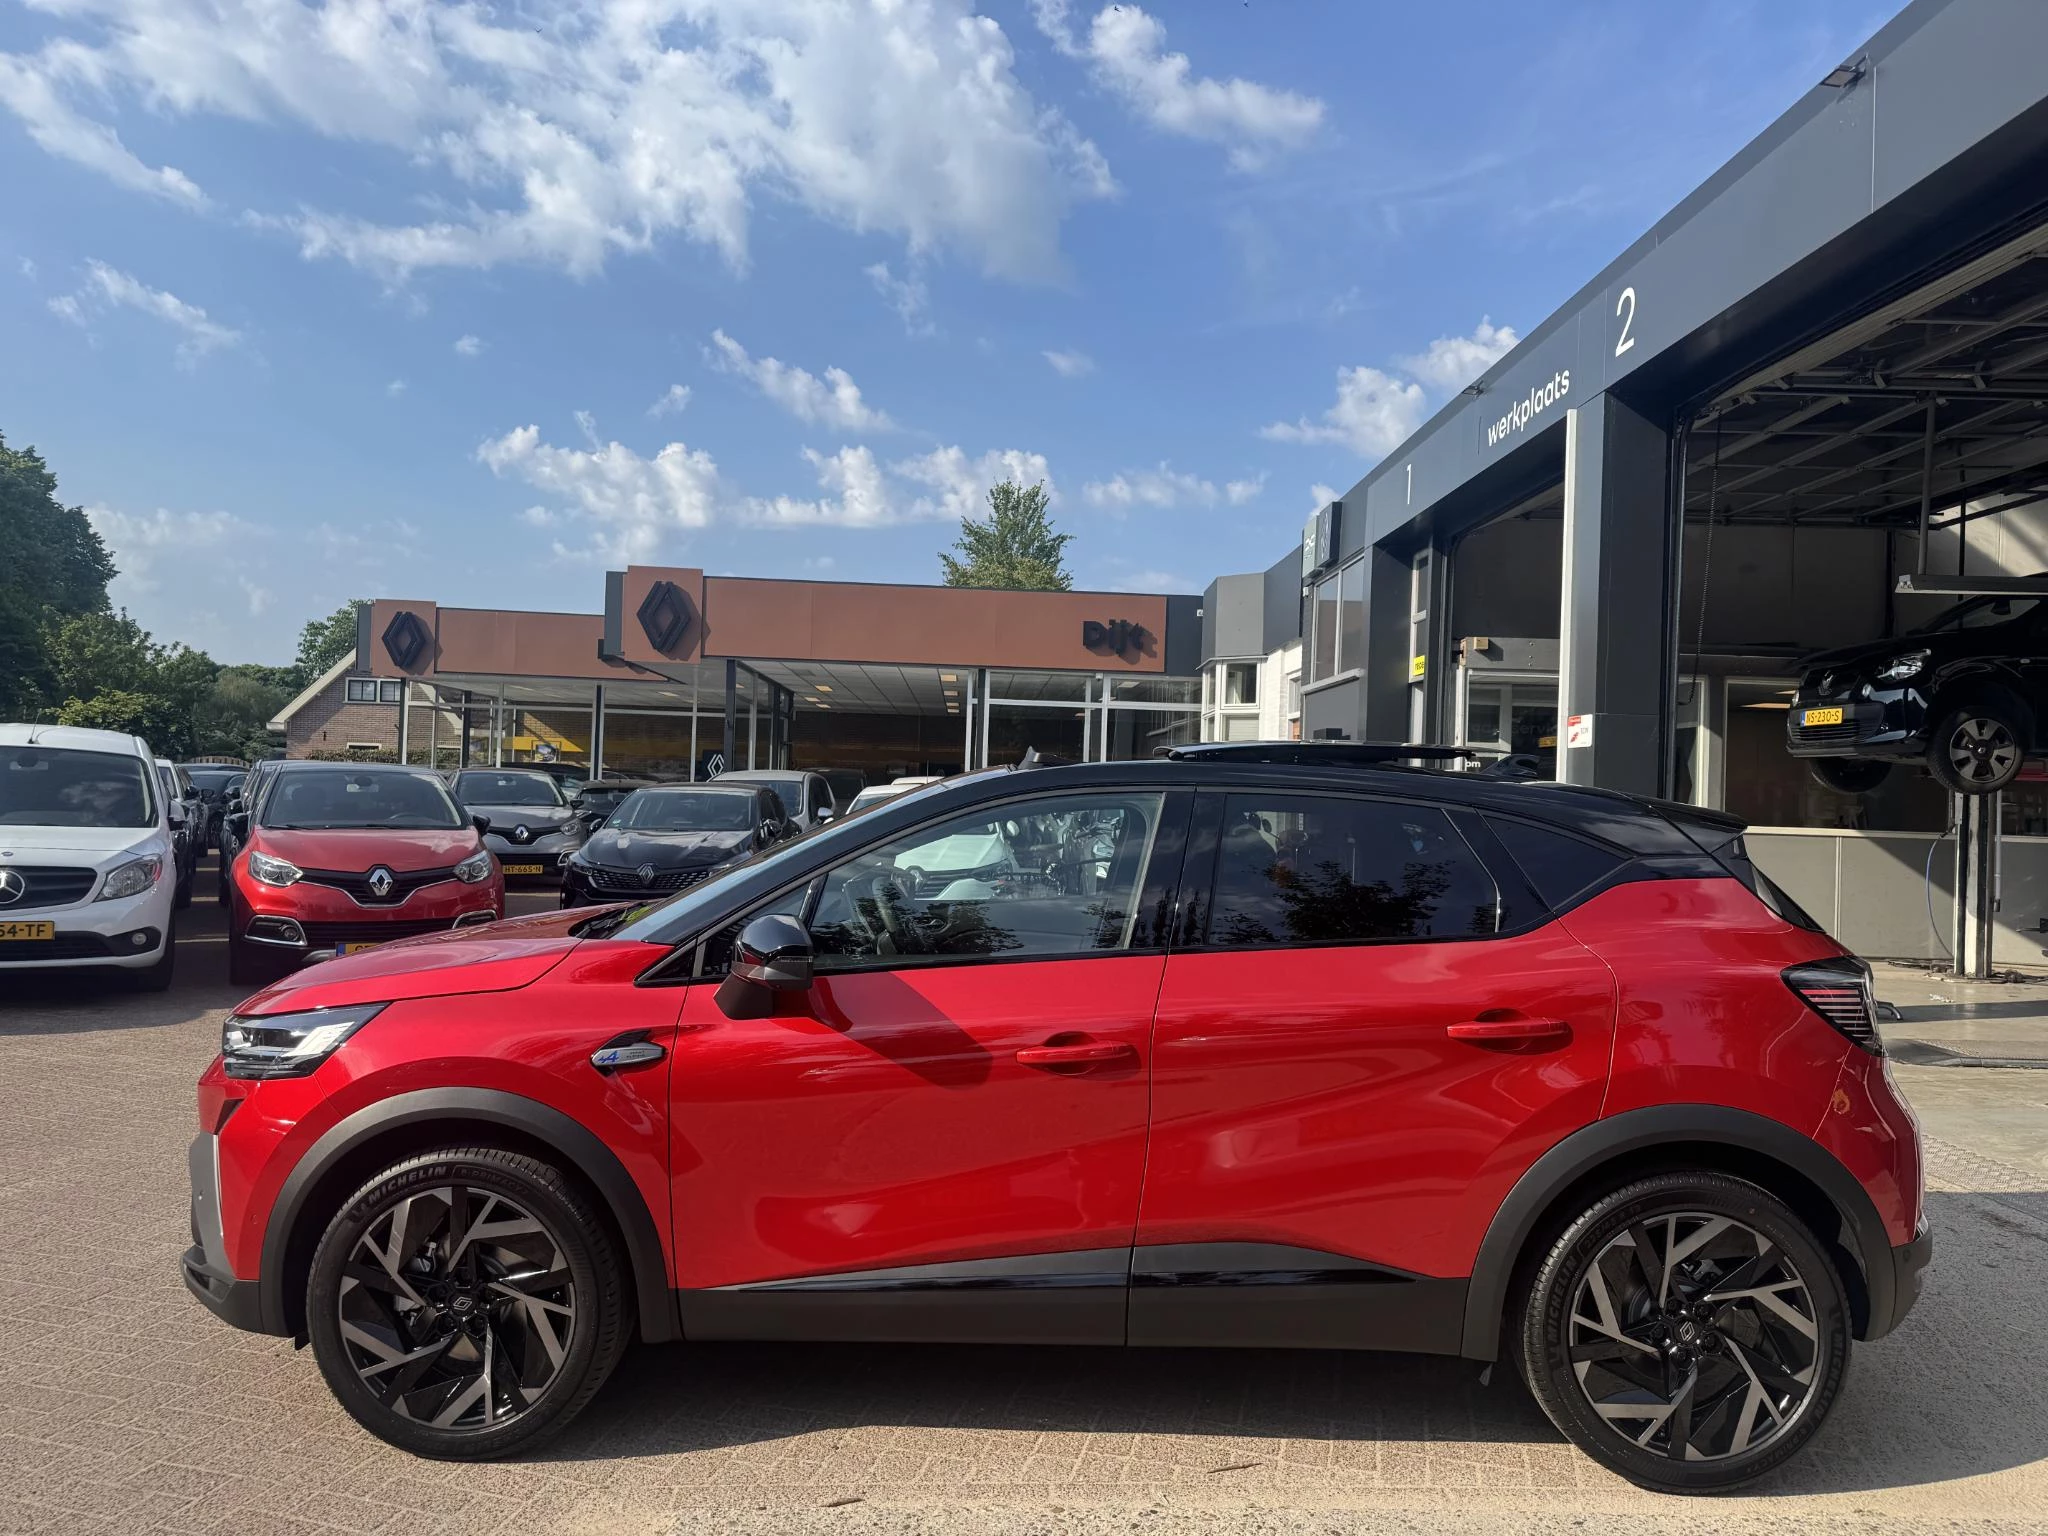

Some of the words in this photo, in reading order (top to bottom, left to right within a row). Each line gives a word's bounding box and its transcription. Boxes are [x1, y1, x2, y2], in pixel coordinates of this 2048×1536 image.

[1615, 287, 1636, 358] 2
[1487, 369, 1570, 447] werkplaats
[1406, 463, 1412, 505] 1
[368, 1165, 448, 1204] MICHELIN
[1547, 1255, 1578, 1344] MICHELIN
